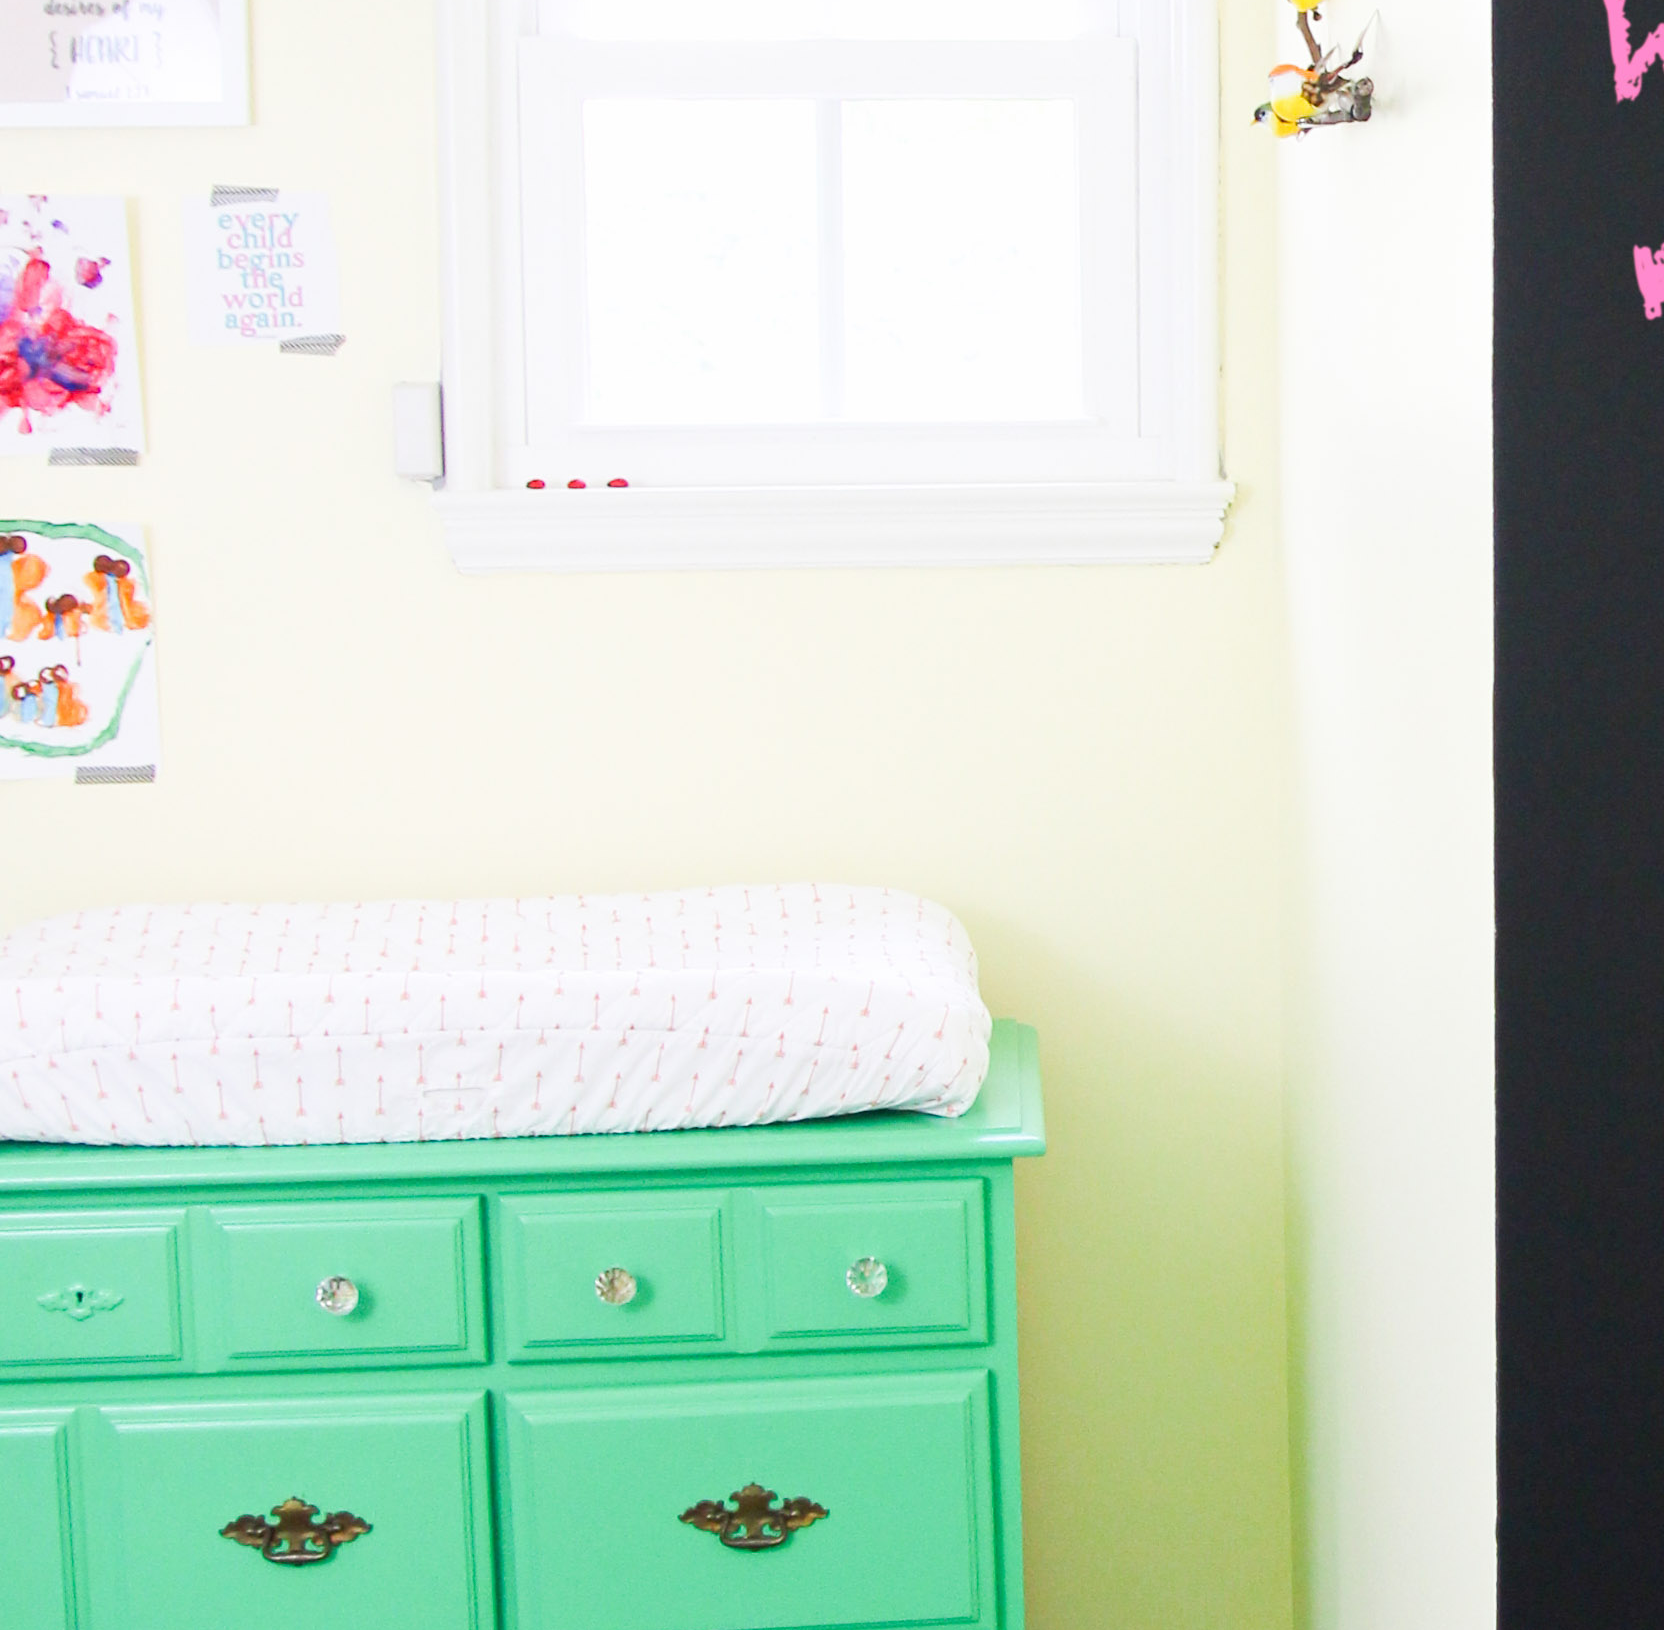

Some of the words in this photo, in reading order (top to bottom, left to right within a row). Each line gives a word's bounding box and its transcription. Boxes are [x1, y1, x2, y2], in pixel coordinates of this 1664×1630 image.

[217, 211, 299, 230] every
[227, 225, 293, 249] child
[216, 247, 305, 272] begins
[240, 267, 283, 289] the
[222, 285, 304, 309] world
[225, 309, 303, 338] again.
